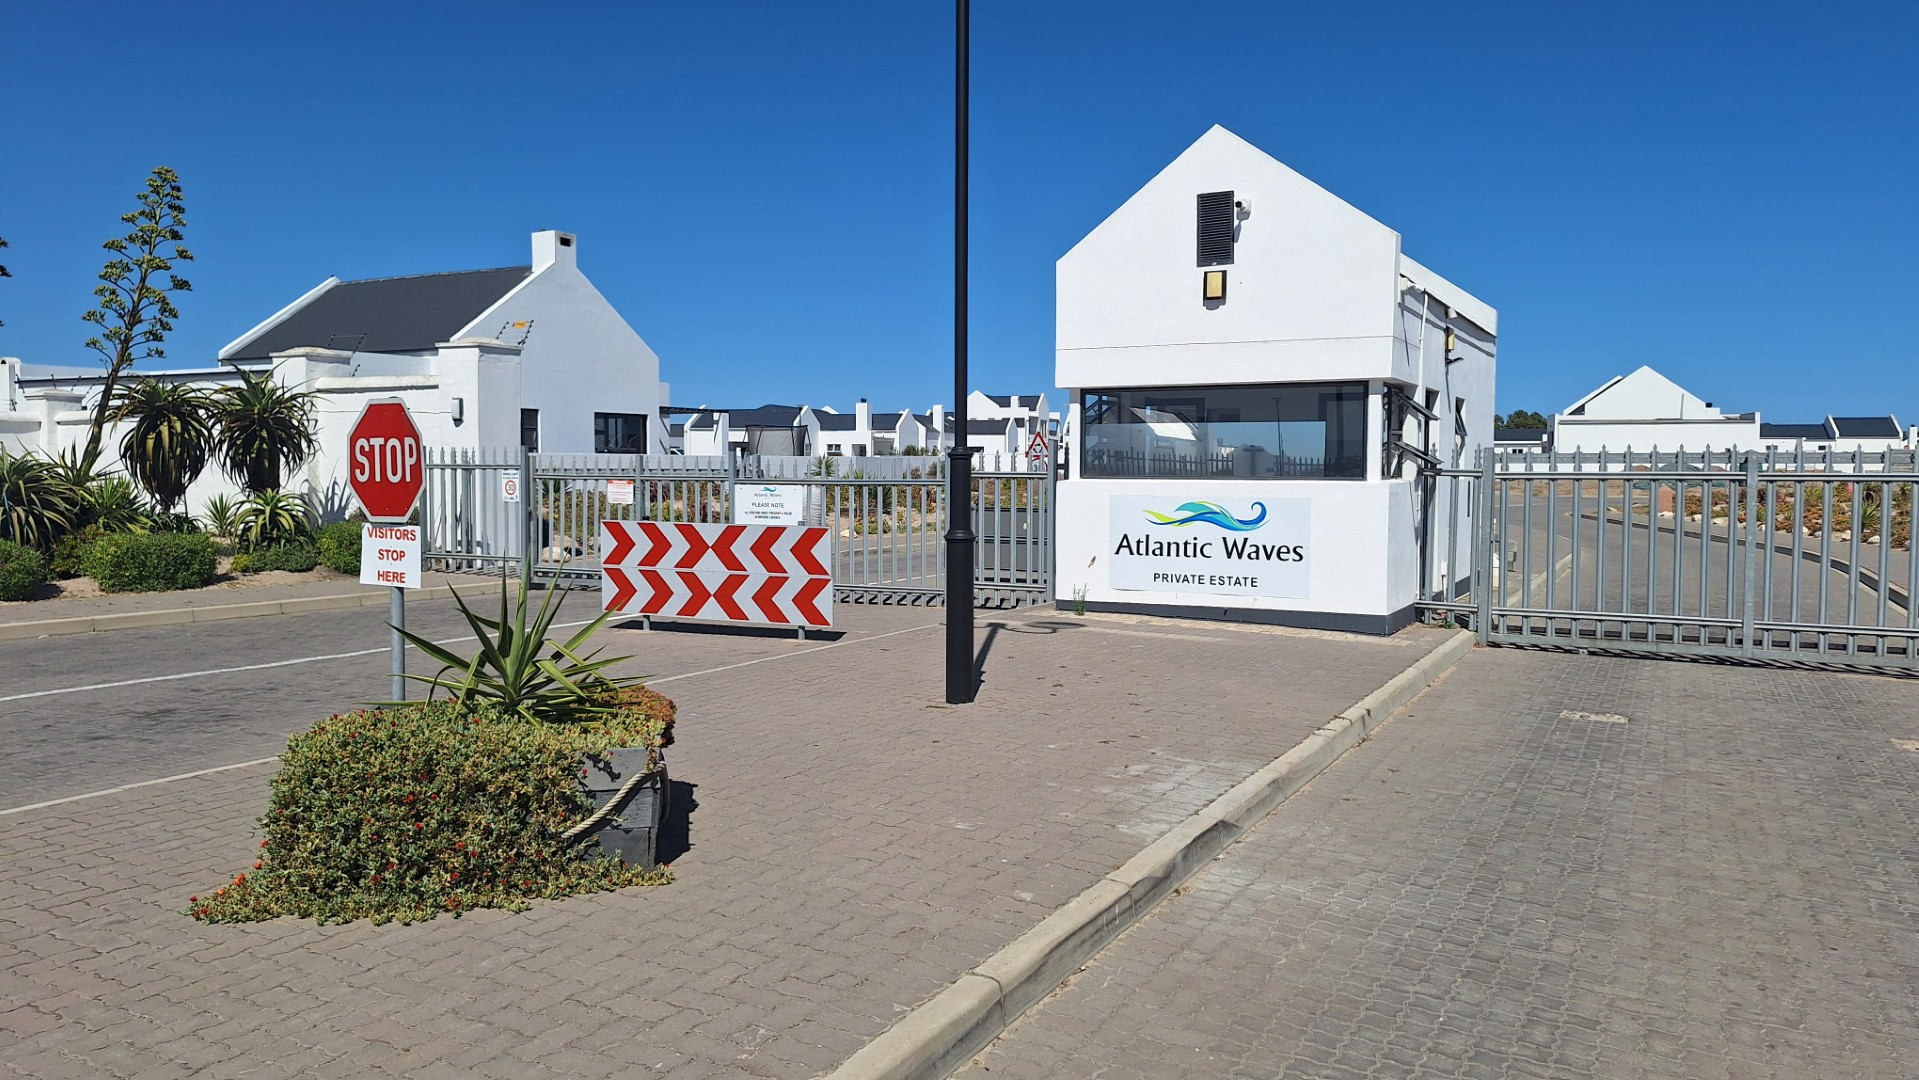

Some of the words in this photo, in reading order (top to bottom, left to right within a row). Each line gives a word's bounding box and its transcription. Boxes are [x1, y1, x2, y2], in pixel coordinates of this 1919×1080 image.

[355, 436, 417, 483] STOP
[367, 527, 417, 541] VISITORS
[377, 548, 407, 562] STOP
[1114, 533, 1213, 559] Atlantic
[1221, 536, 1304, 563] Waves
[377, 570, 407, 584] HERE
[1153, 572, 1206, 586] PRIVATE
[1209, 574, 1259, 588] ESTATE
